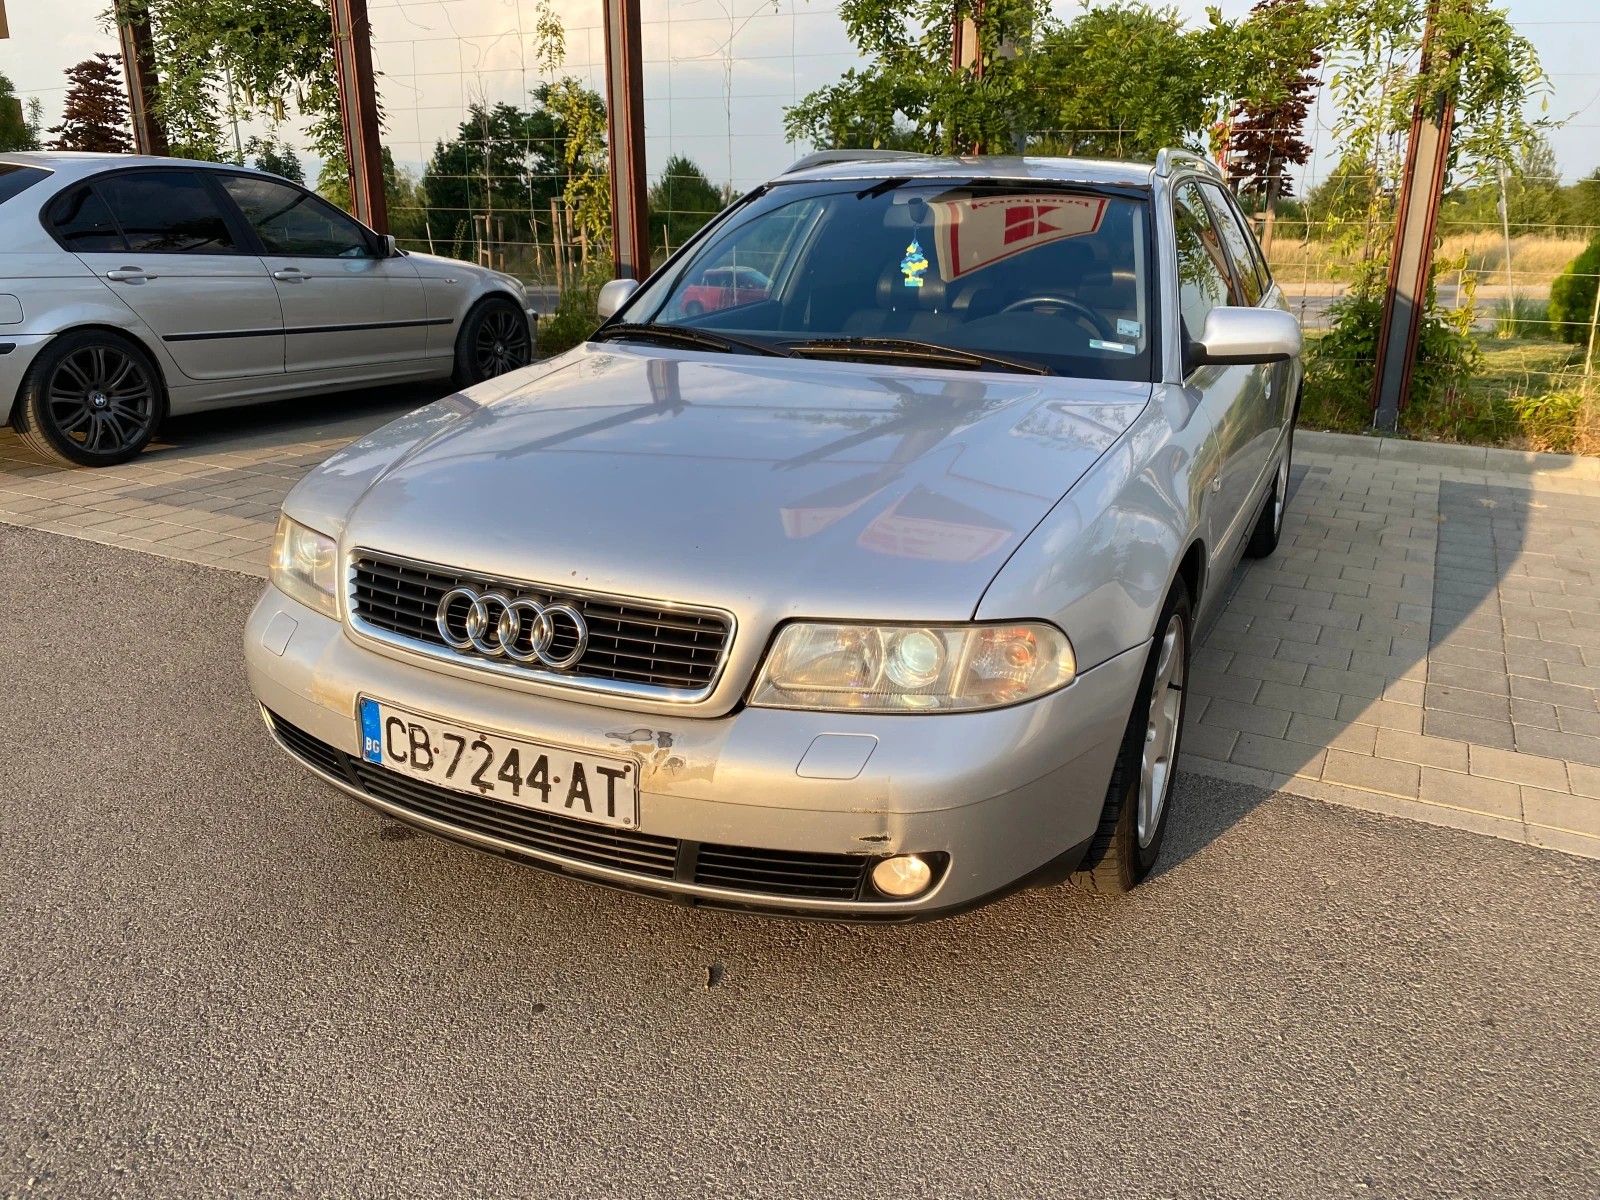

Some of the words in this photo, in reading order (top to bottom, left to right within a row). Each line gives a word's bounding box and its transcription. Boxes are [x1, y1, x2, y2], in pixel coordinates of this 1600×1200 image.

[365, 736, 380, 754] BG
[443, 732, 552, 804] 7244
[564, 761, 626, 818] AT
